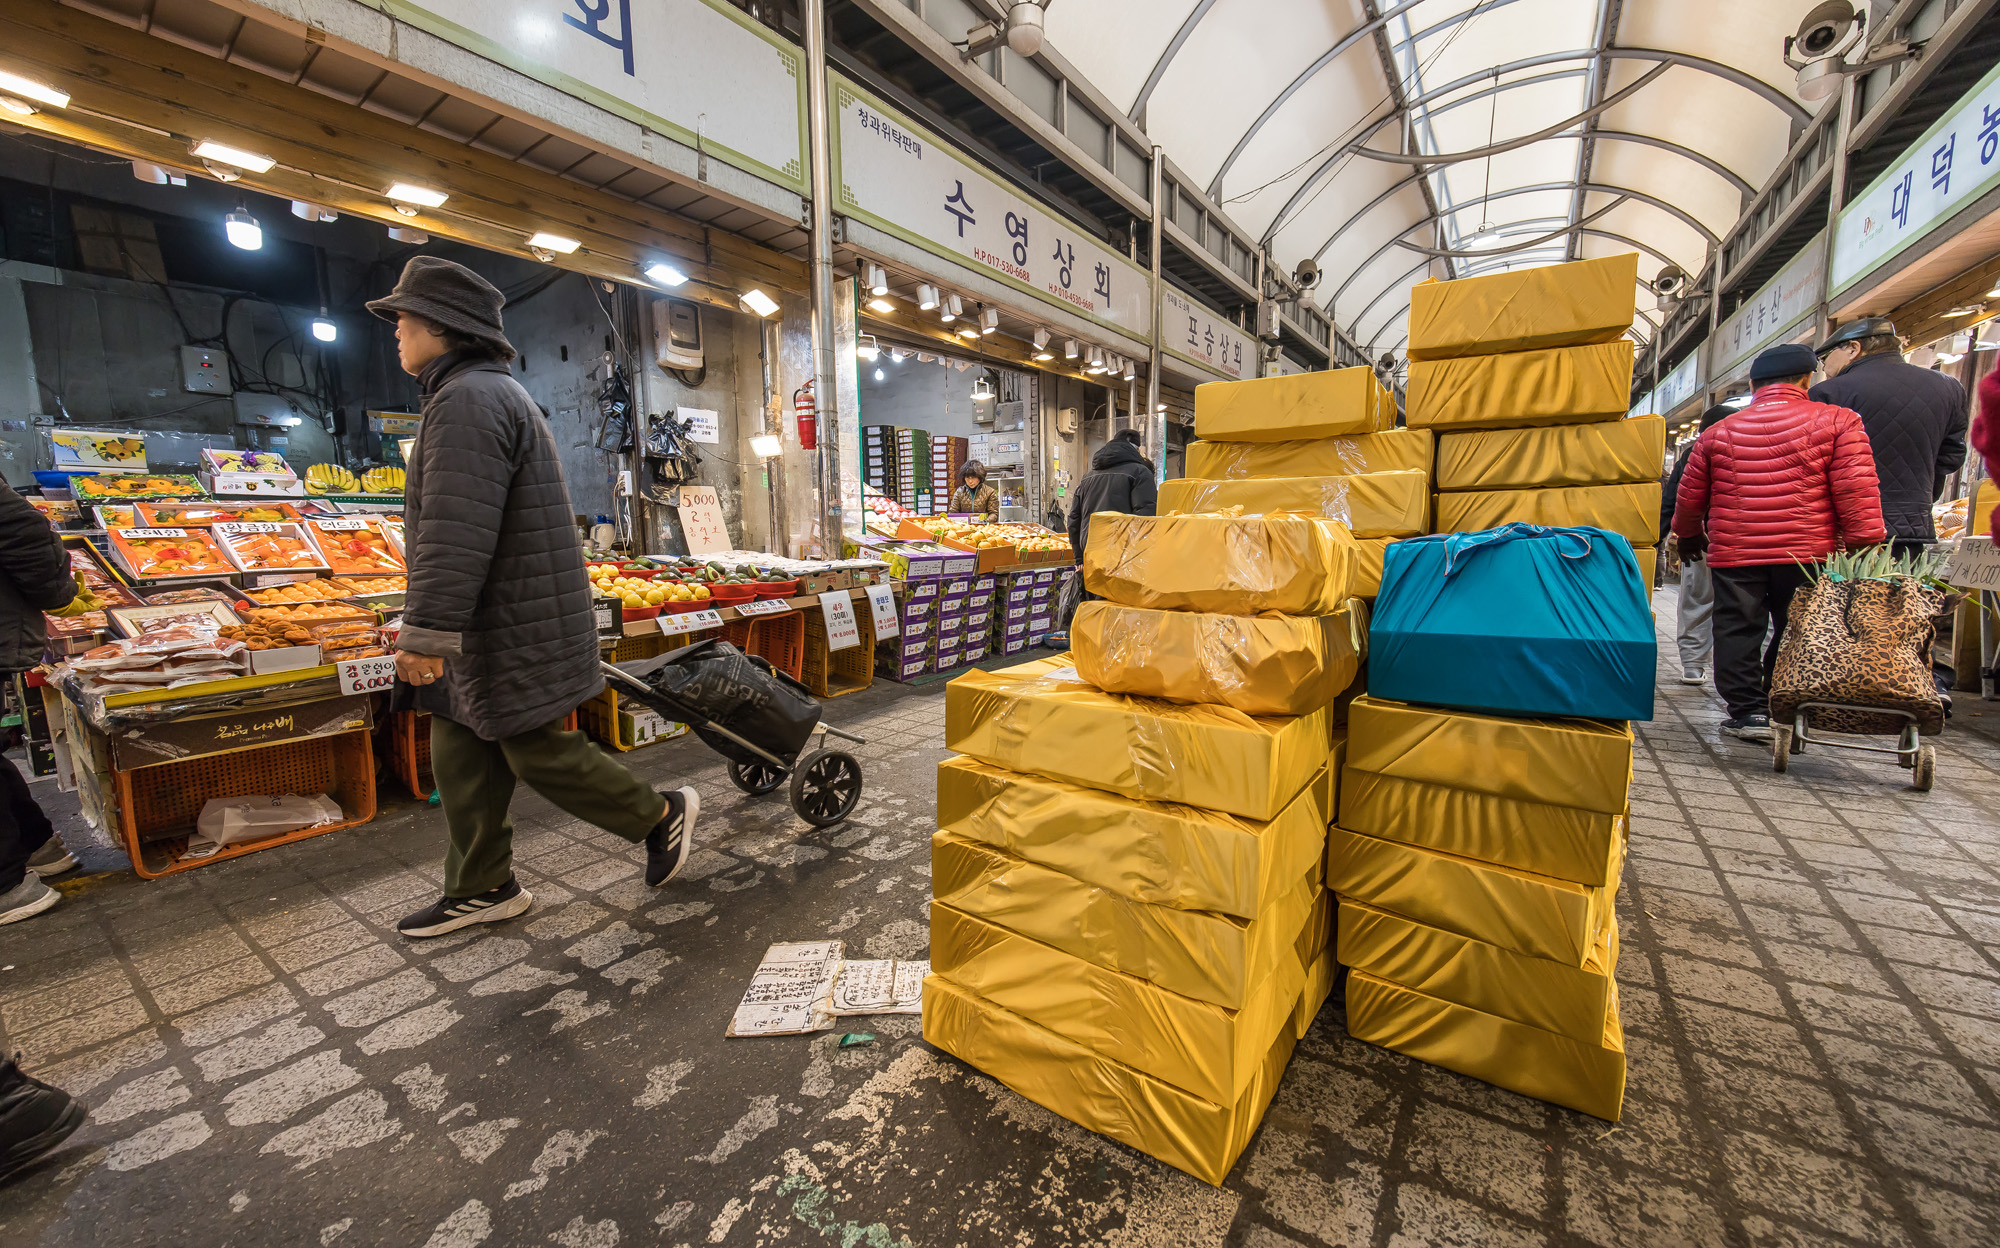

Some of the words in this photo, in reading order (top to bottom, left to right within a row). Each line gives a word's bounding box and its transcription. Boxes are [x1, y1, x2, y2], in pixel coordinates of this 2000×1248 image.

[858, 108, 922, 161] 청과위탁판매
[974, 247, 986, 262] H.P
[987, 255, 1030, 283] 017-530-6688
[1048, 282, 1058, 296] H.P
[1058, 287, 1094, 312] 010-4530-6688
[1187, 315, 1242, 372] 포승상회
[682, 493, 715, 508] 5,000
